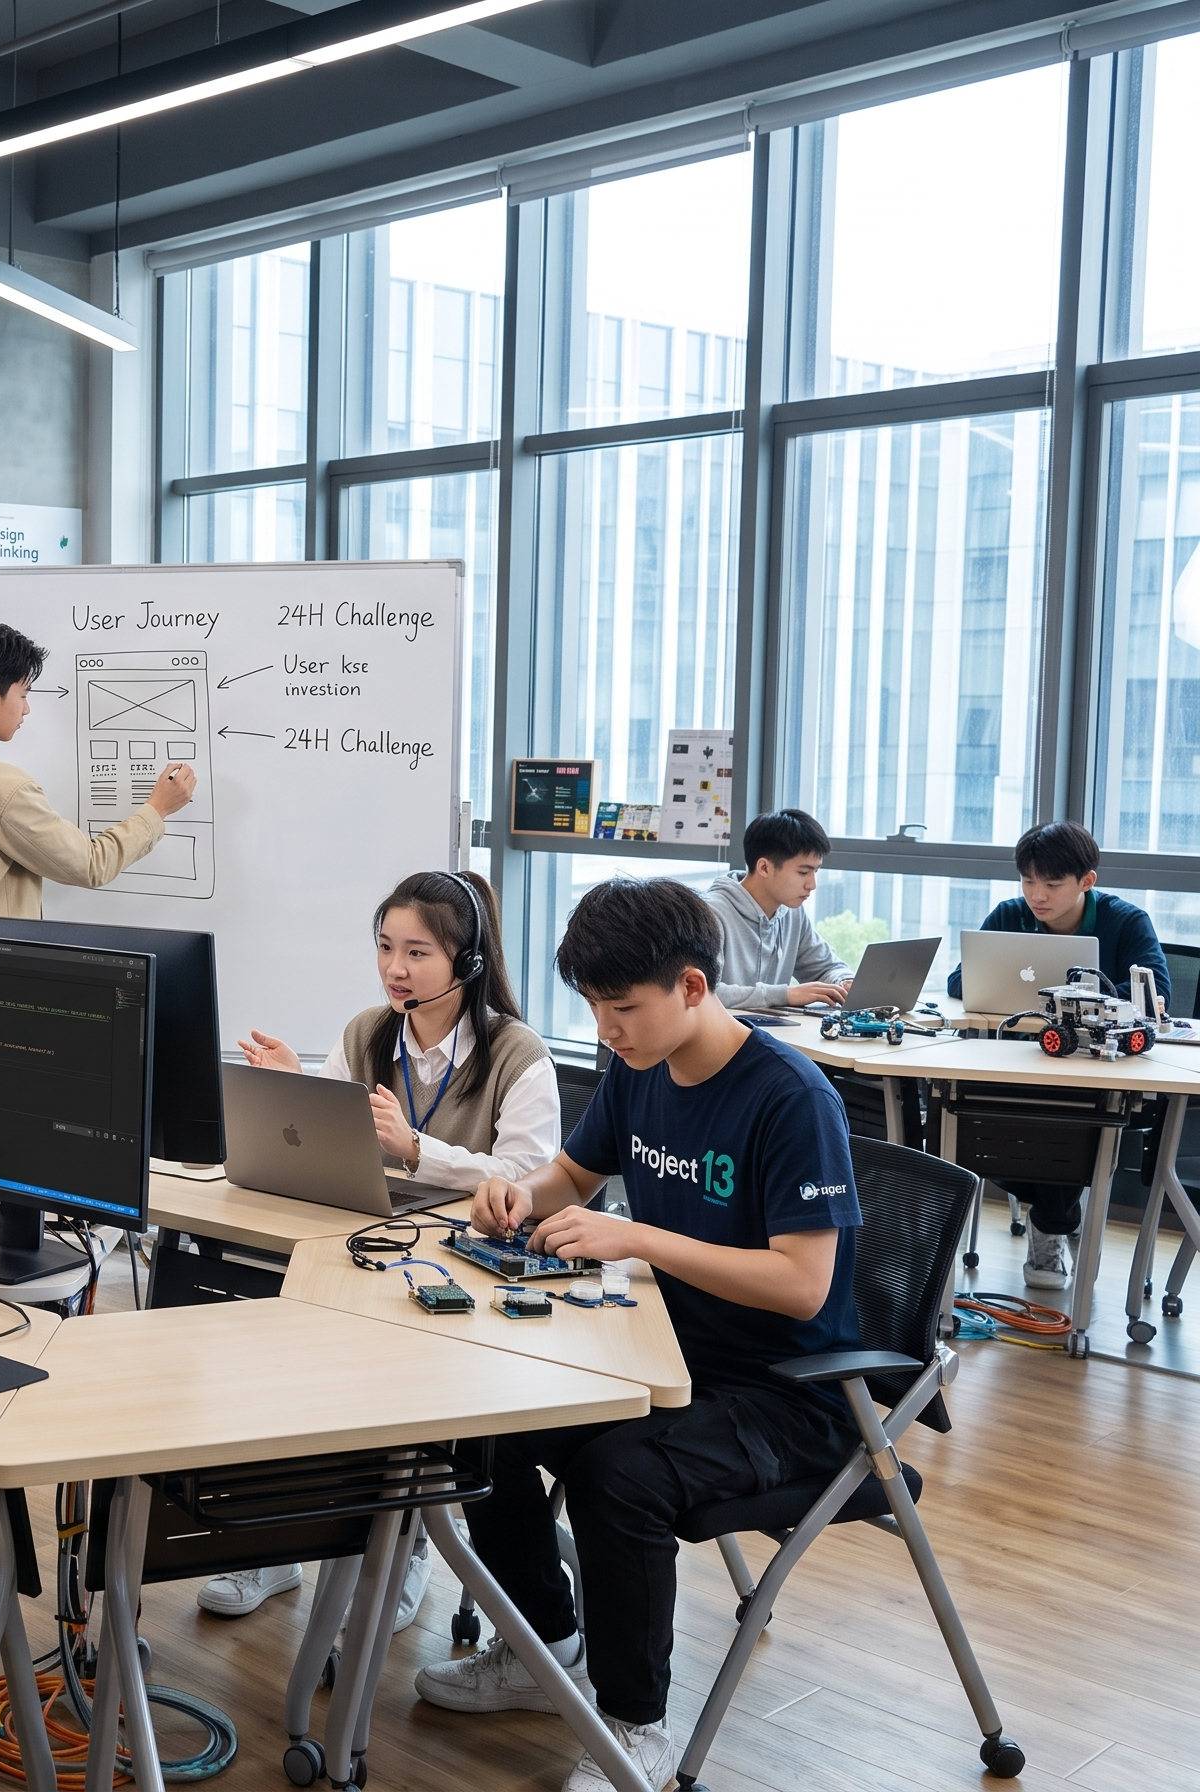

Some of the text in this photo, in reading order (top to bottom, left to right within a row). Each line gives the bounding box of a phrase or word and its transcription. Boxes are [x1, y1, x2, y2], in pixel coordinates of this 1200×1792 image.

[73, 601, 219, 639] User Journey
[278, 602, 434, 642] 24H Challenge
[285, 654, 329, 674] User
[286, 683, 360, 695] investion
[284, 728, 433, 770] 24H Challenge
[632, 1135, 735, 1197] Project 13
